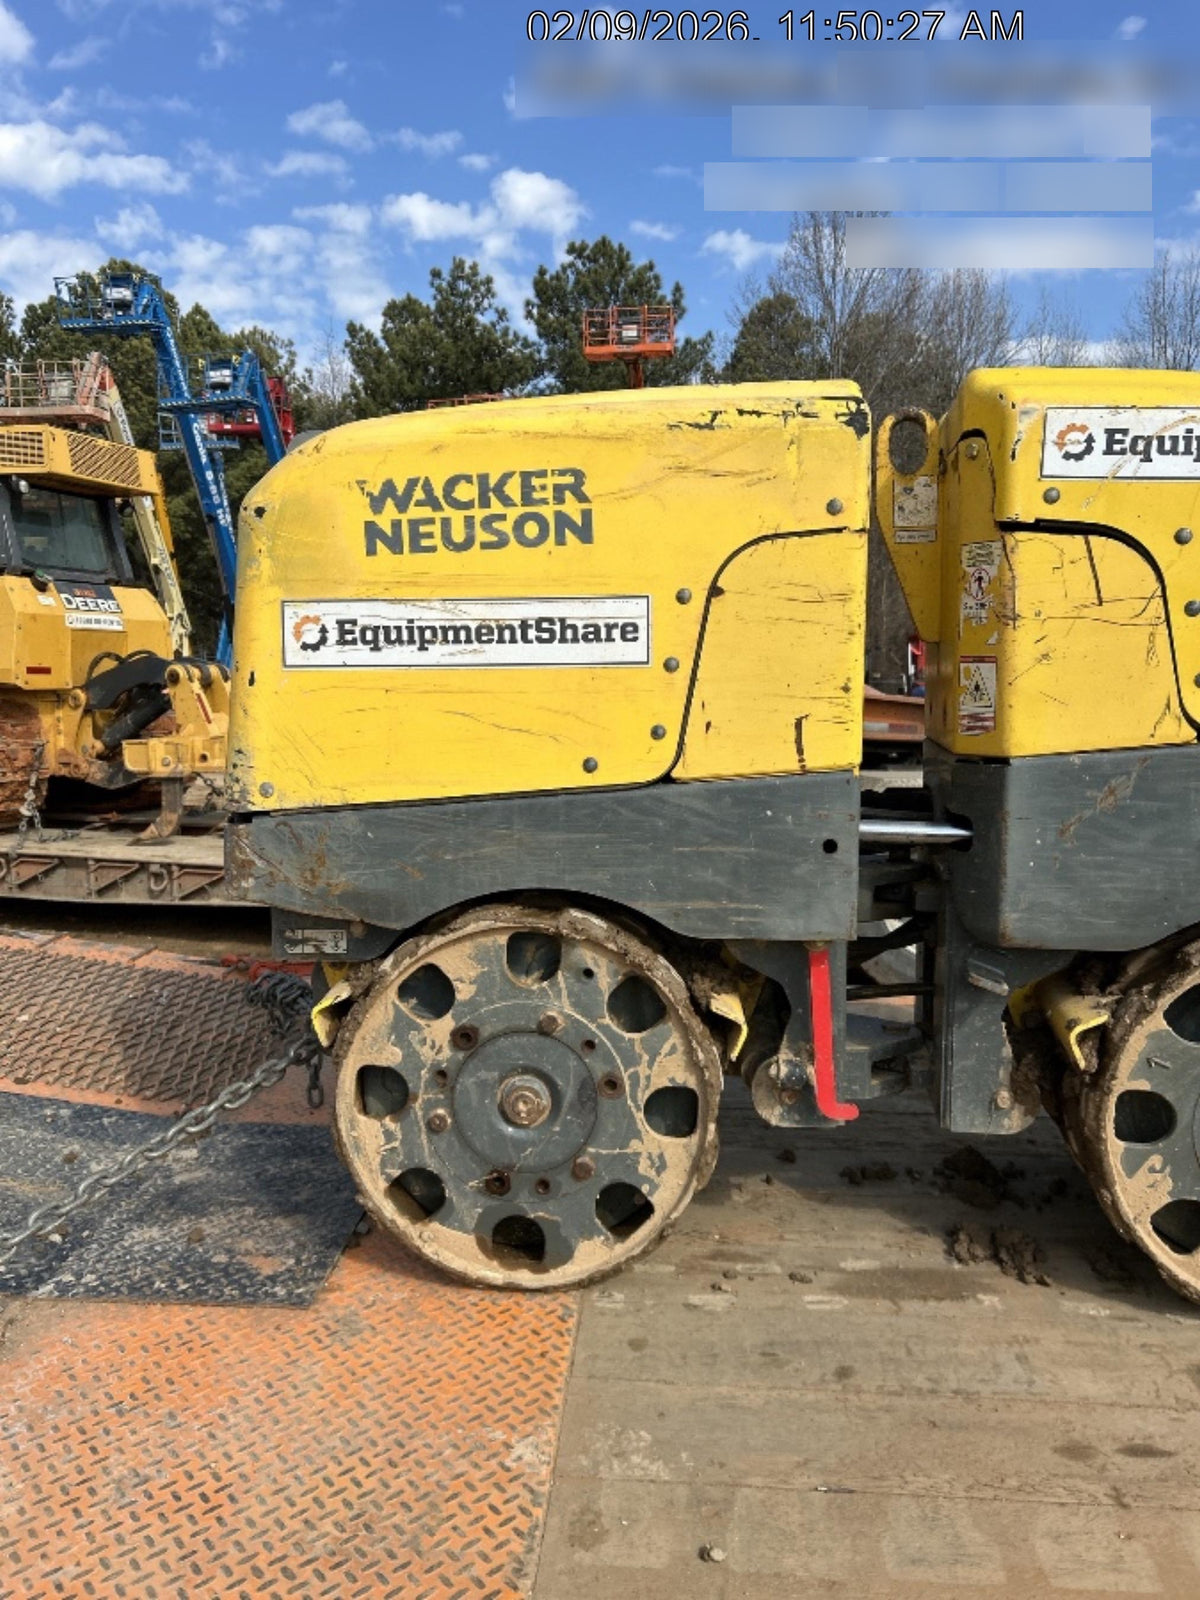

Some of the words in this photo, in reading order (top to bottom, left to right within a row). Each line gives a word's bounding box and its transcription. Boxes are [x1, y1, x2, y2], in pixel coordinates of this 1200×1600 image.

[356, 468, 592, 515] WACKER
[364, 508, 594, 557] NEUSON
[60, 593, 123, 612] DEERE
[335, 617, 639, 651] EquipmentShare
